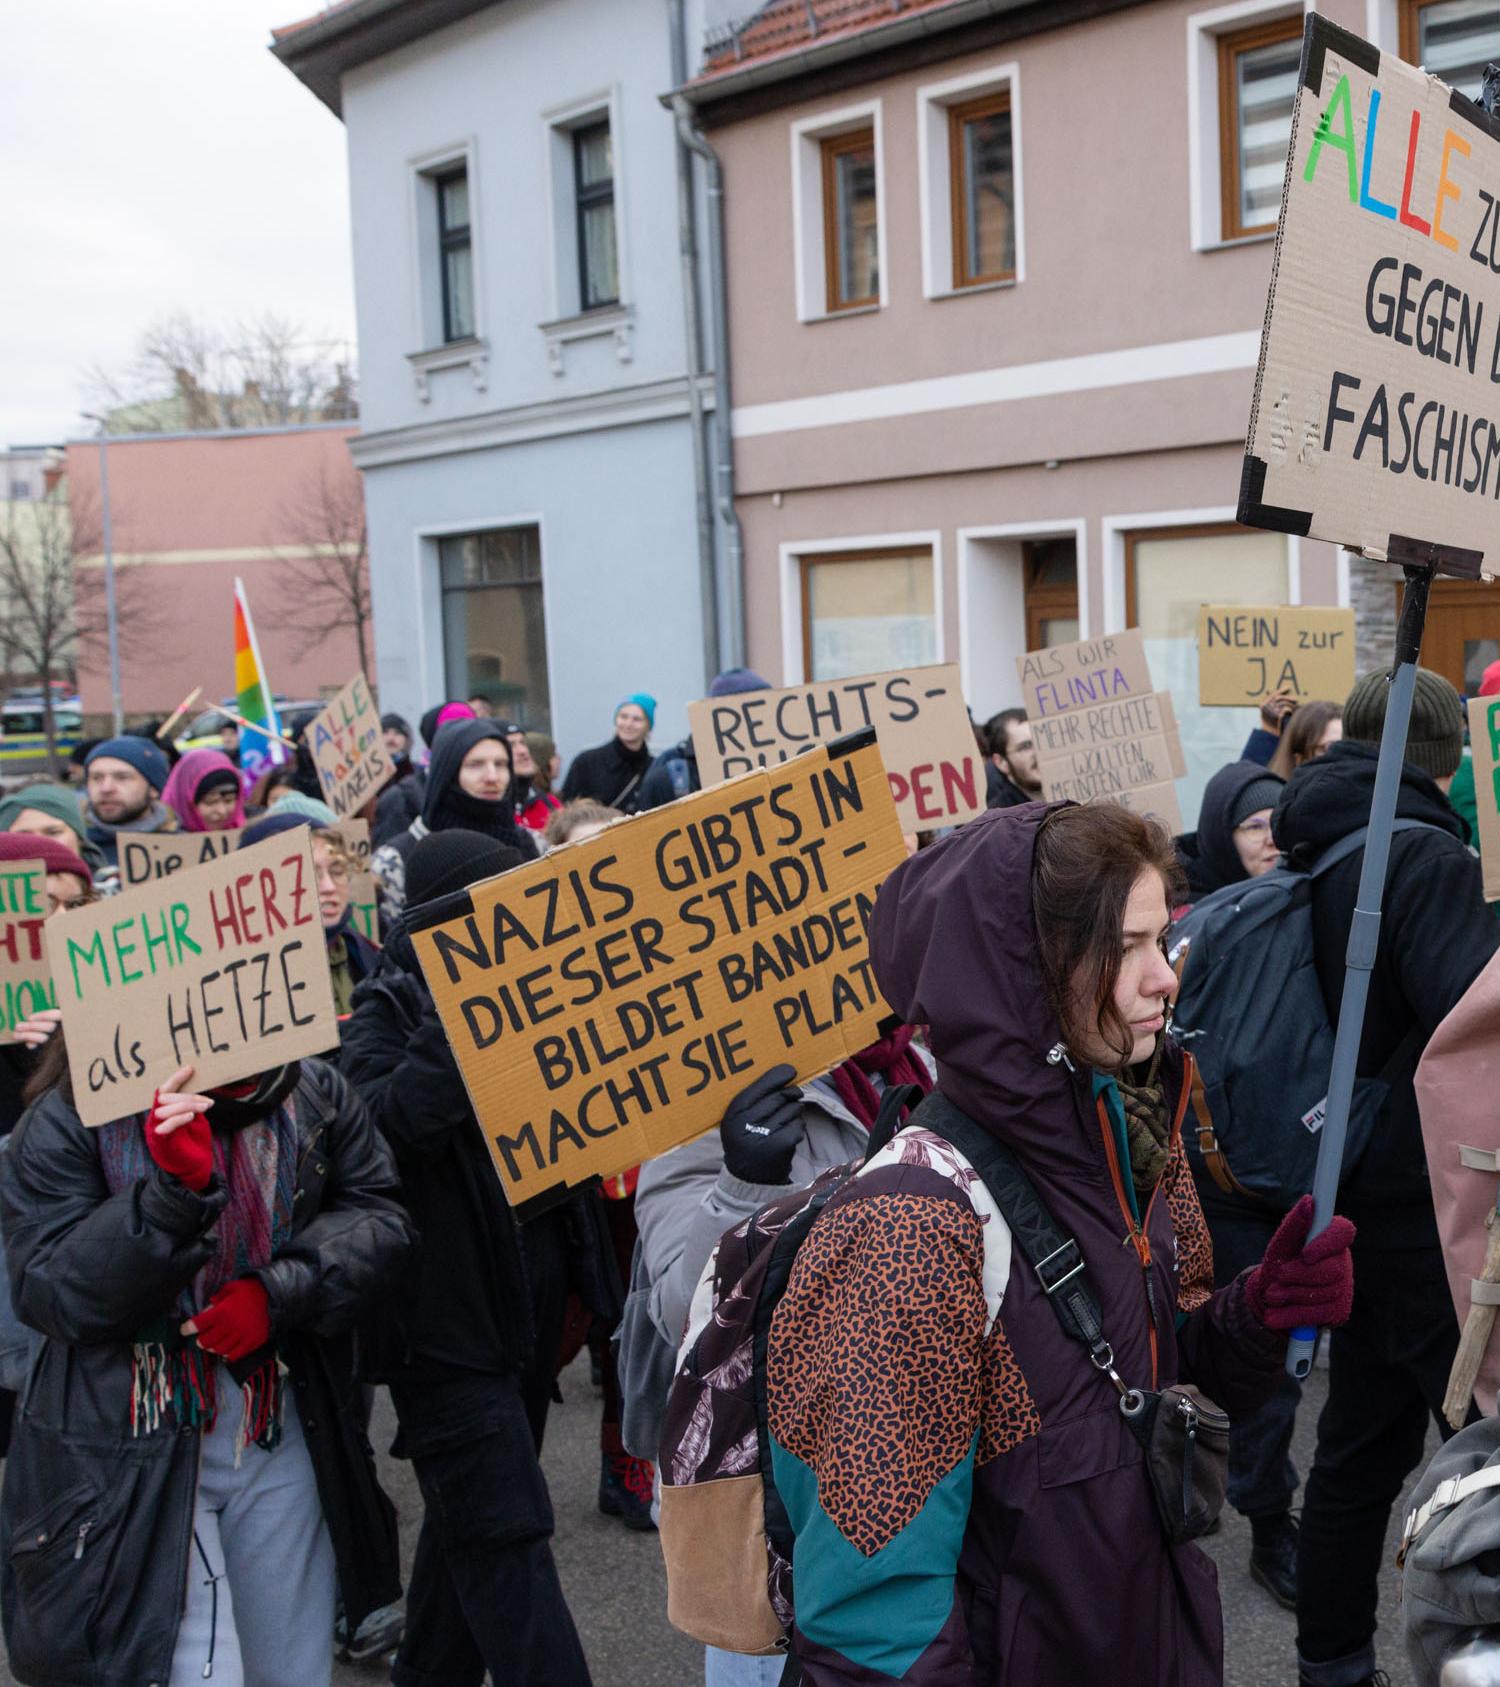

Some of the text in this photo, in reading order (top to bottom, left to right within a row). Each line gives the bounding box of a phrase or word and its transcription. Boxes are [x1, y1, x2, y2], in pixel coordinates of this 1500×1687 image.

[1303, 74, 1471, 252] ALLE
[1366, 256, 1482, 374] GEGEN
[1022, 638, 1118, 683] ALS WIR
[1207, 616, 1279, 648] NEIN
[1246, 657, 1308, 697] J.A.
[315, 679, 369, 757] ALLE
[711, 677, 947, 756] RECHTS-
[1032, 698, 1158, 752] MEHR RECHTE
[1034, 667, 1131, 716] FLINTA
[332, 750, 384, 816] NAZIS
[432, 760, 864, 984] NAZIS GIBTS IN
[66, 853, 313, 1000] MEHR HERZ
[87, 941, 316, 1091] als HETZE
[460, 917, 674, 1049] DIESER
[533, 971, 703, 1091] BILDET
[495, 1052, 672, 1183] MACHT
[681, 1019, 755, 1097] SIE
